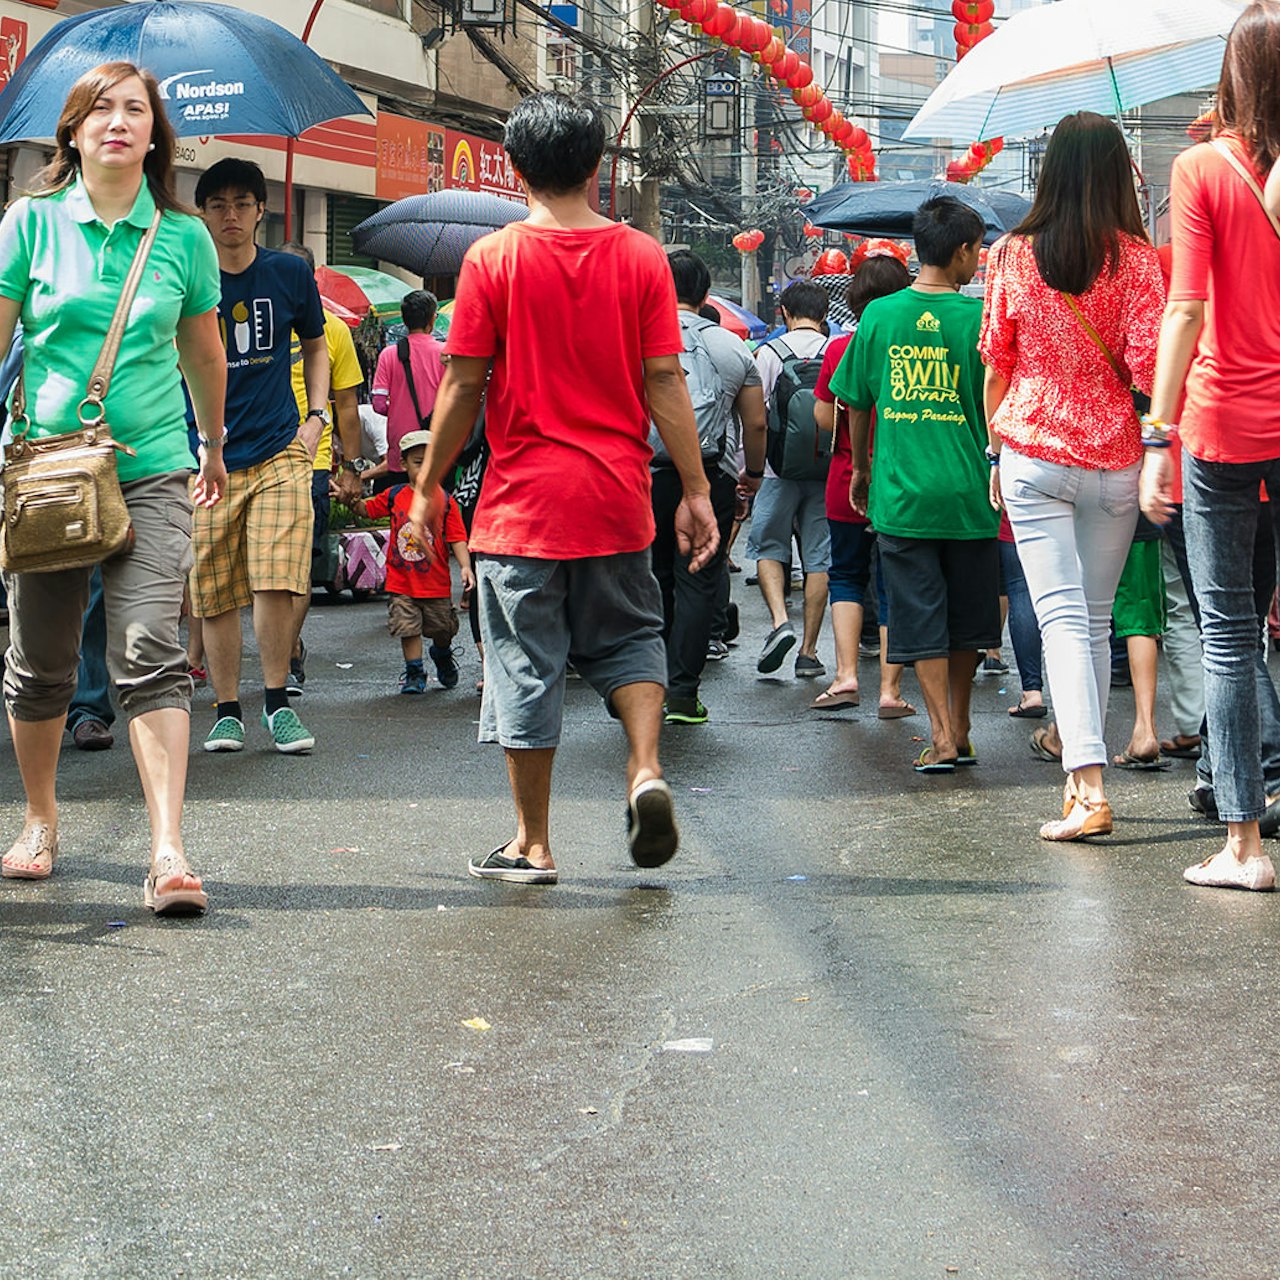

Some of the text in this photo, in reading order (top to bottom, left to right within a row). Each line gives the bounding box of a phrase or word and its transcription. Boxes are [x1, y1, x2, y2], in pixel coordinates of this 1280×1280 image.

[176, 81, 244, 99] Nordson
[707, 81, 735, 94] BDO
[183, 102, 230, 116] APASI
[888, 345, 949, 360] COMMIT
[892, 384, 959, 404] Olivare
